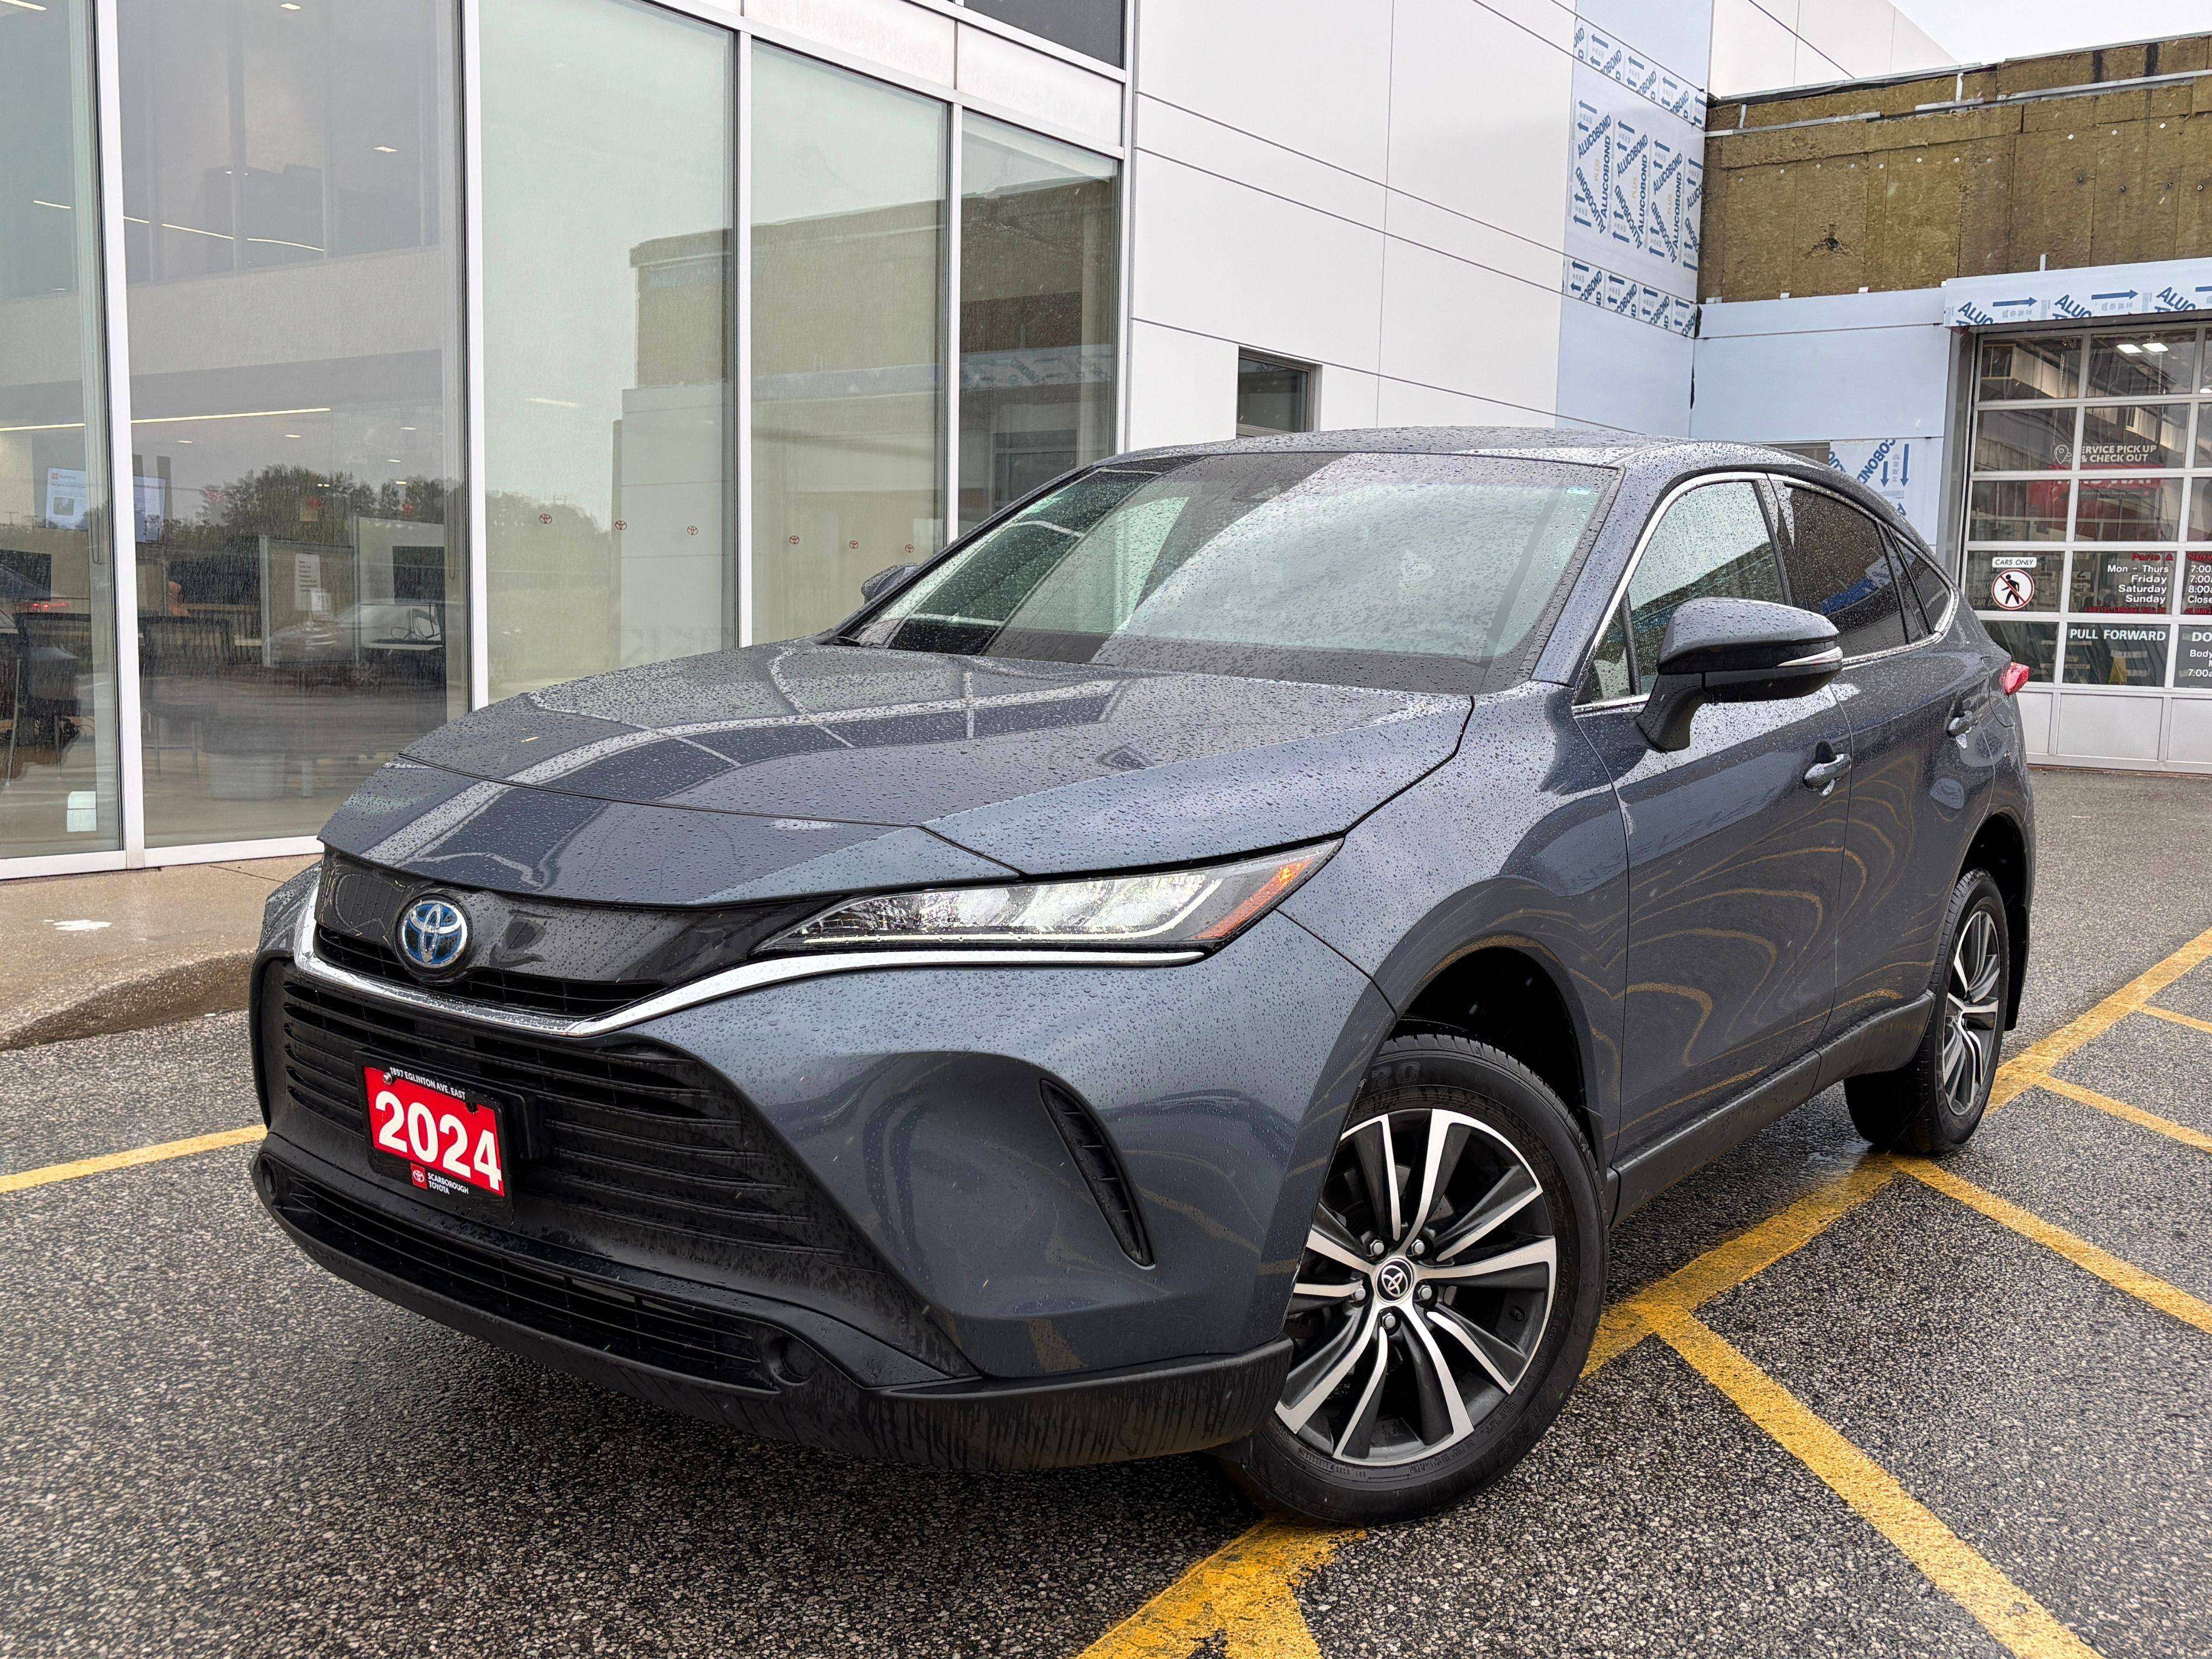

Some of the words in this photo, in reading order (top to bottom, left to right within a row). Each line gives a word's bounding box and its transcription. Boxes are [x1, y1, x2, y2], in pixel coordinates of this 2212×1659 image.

[1577, 115, 1611, 159] ALUCOBOND
[1616, 134, 1648, 177] ALUCOBOND
[1601, 135, 1611, 219] ALUCOBOND
[1653, 152, 1683, 195] ALUCOBOND
[1575, 166, 1606, 234] ALUCOBOND
[1638, 154, 1647, 234] ALUCOBOND
[1615, 185, 1643, 249] ALUCOBOND
[1672, 172, 1682, 249] ALUCOBOND
[1651, 202, 1677, 264] ALUCOBOND
[2082, 445, 2115, 453] ERVICE
[2117, 445, 2141, 453] PICK
[2142, 445, 2157, 453] UP
[2090, 454, 2124, 463] CHECK
[2126, 454, 2149, 462] OUT
[2107, 565, 2128, 573] Mon
[2142, 565, 2169, 573] Thurs
[2131, 575, 2167, 584] Friday
[2118, 584, 2167, 593] Saturday
[2125, 595, 2166, 604] Sunday
[2070, 629, 2099, 639] PULL
[2104, 630, 2166, 641] FORWARD
[2192, 631, 2212, 642] DO
[2190, 649, 2212, 659] Body
[404, 1071, 436, 1089] EGLINTON
[450, 1088, 465, 1100] EAST
[376, 1090, 502, 1191] 2024
[427, 1172, 469, 1195] SCARBOROUGH
[429, 1180, 450, 1195] TOYOTA
